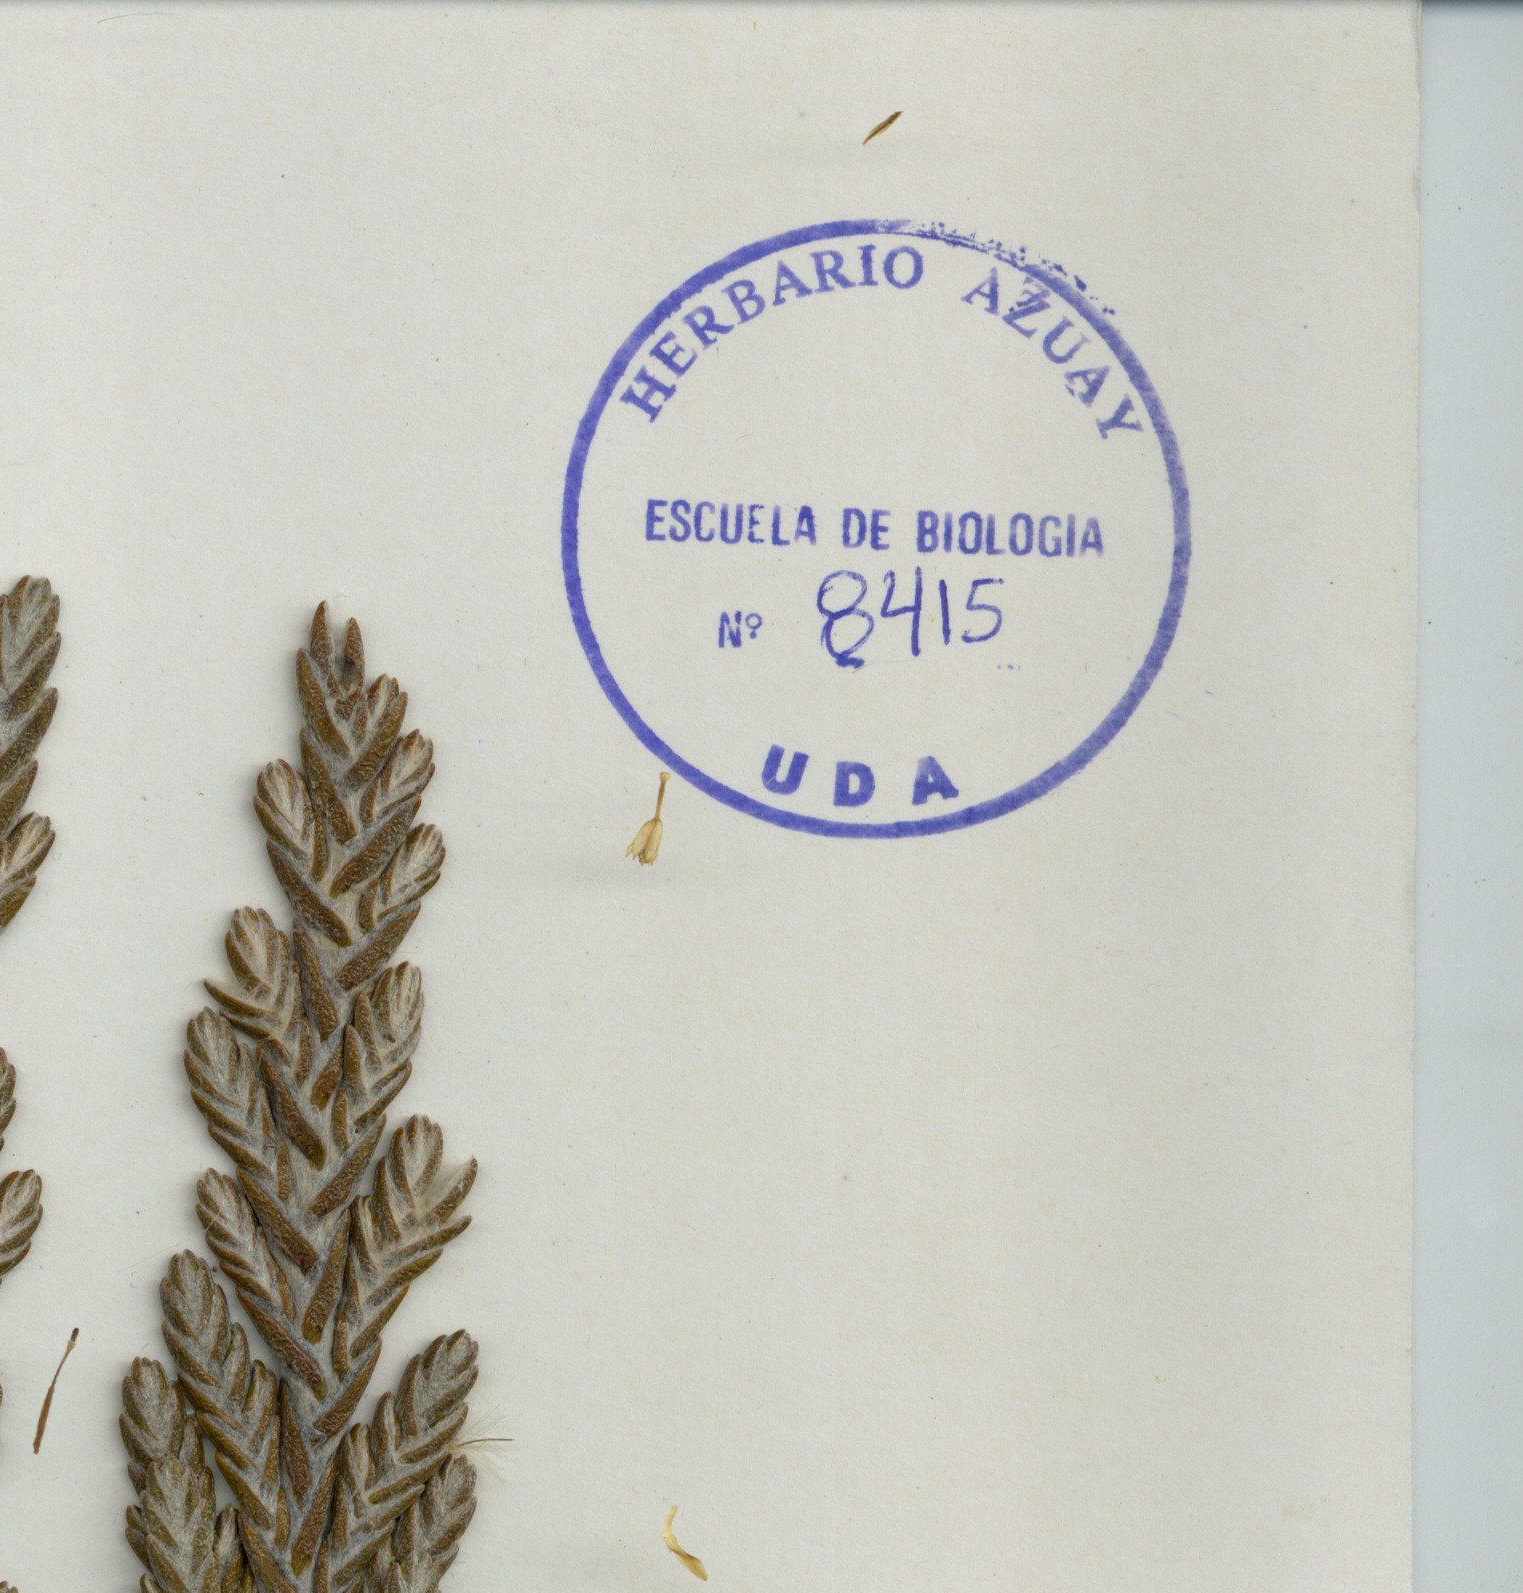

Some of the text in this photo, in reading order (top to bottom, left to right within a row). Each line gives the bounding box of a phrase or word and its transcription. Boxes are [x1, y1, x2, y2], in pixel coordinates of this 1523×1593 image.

[620, 243, 1144, 439] HERBARIO AZUAY
[644, 498, 1105, 558] ESCUELA DE BIOLOGIA
[816, 567, 1005, 669] 8415
